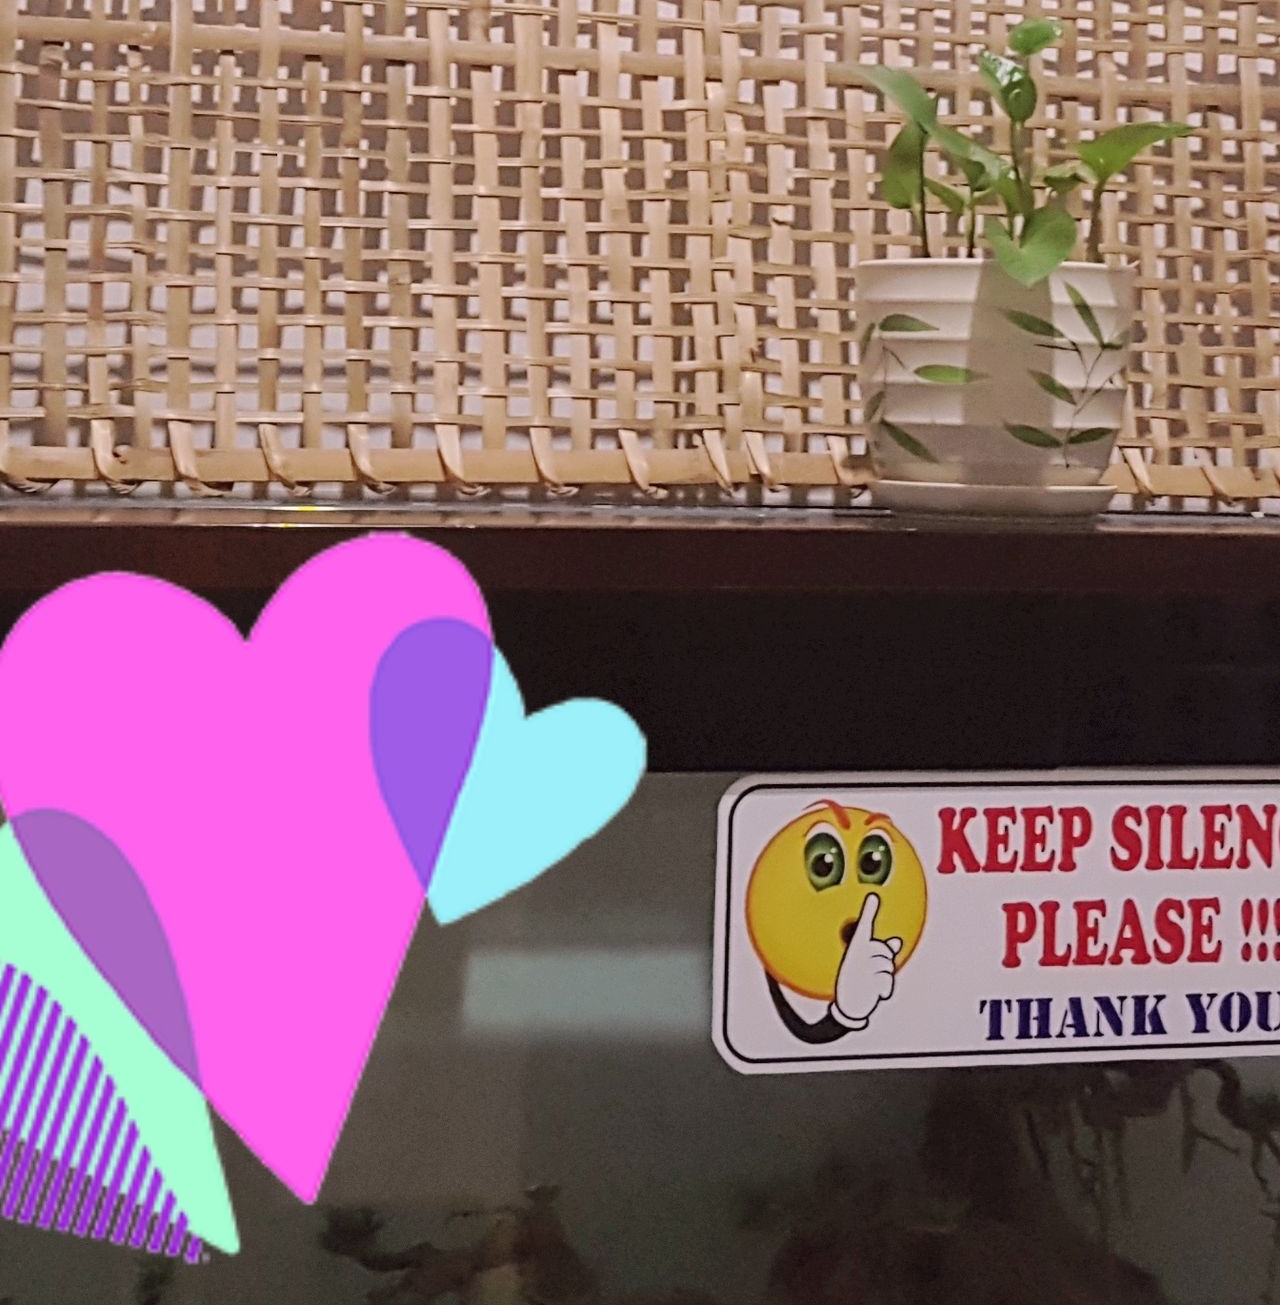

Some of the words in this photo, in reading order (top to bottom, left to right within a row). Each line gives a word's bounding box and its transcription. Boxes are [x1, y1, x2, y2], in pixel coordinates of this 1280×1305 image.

[937, 805, 1093, 874] KEEP
[1002, 897, 1222, 968] PLEASE
[979, 994, 1167, 1040] THANK
